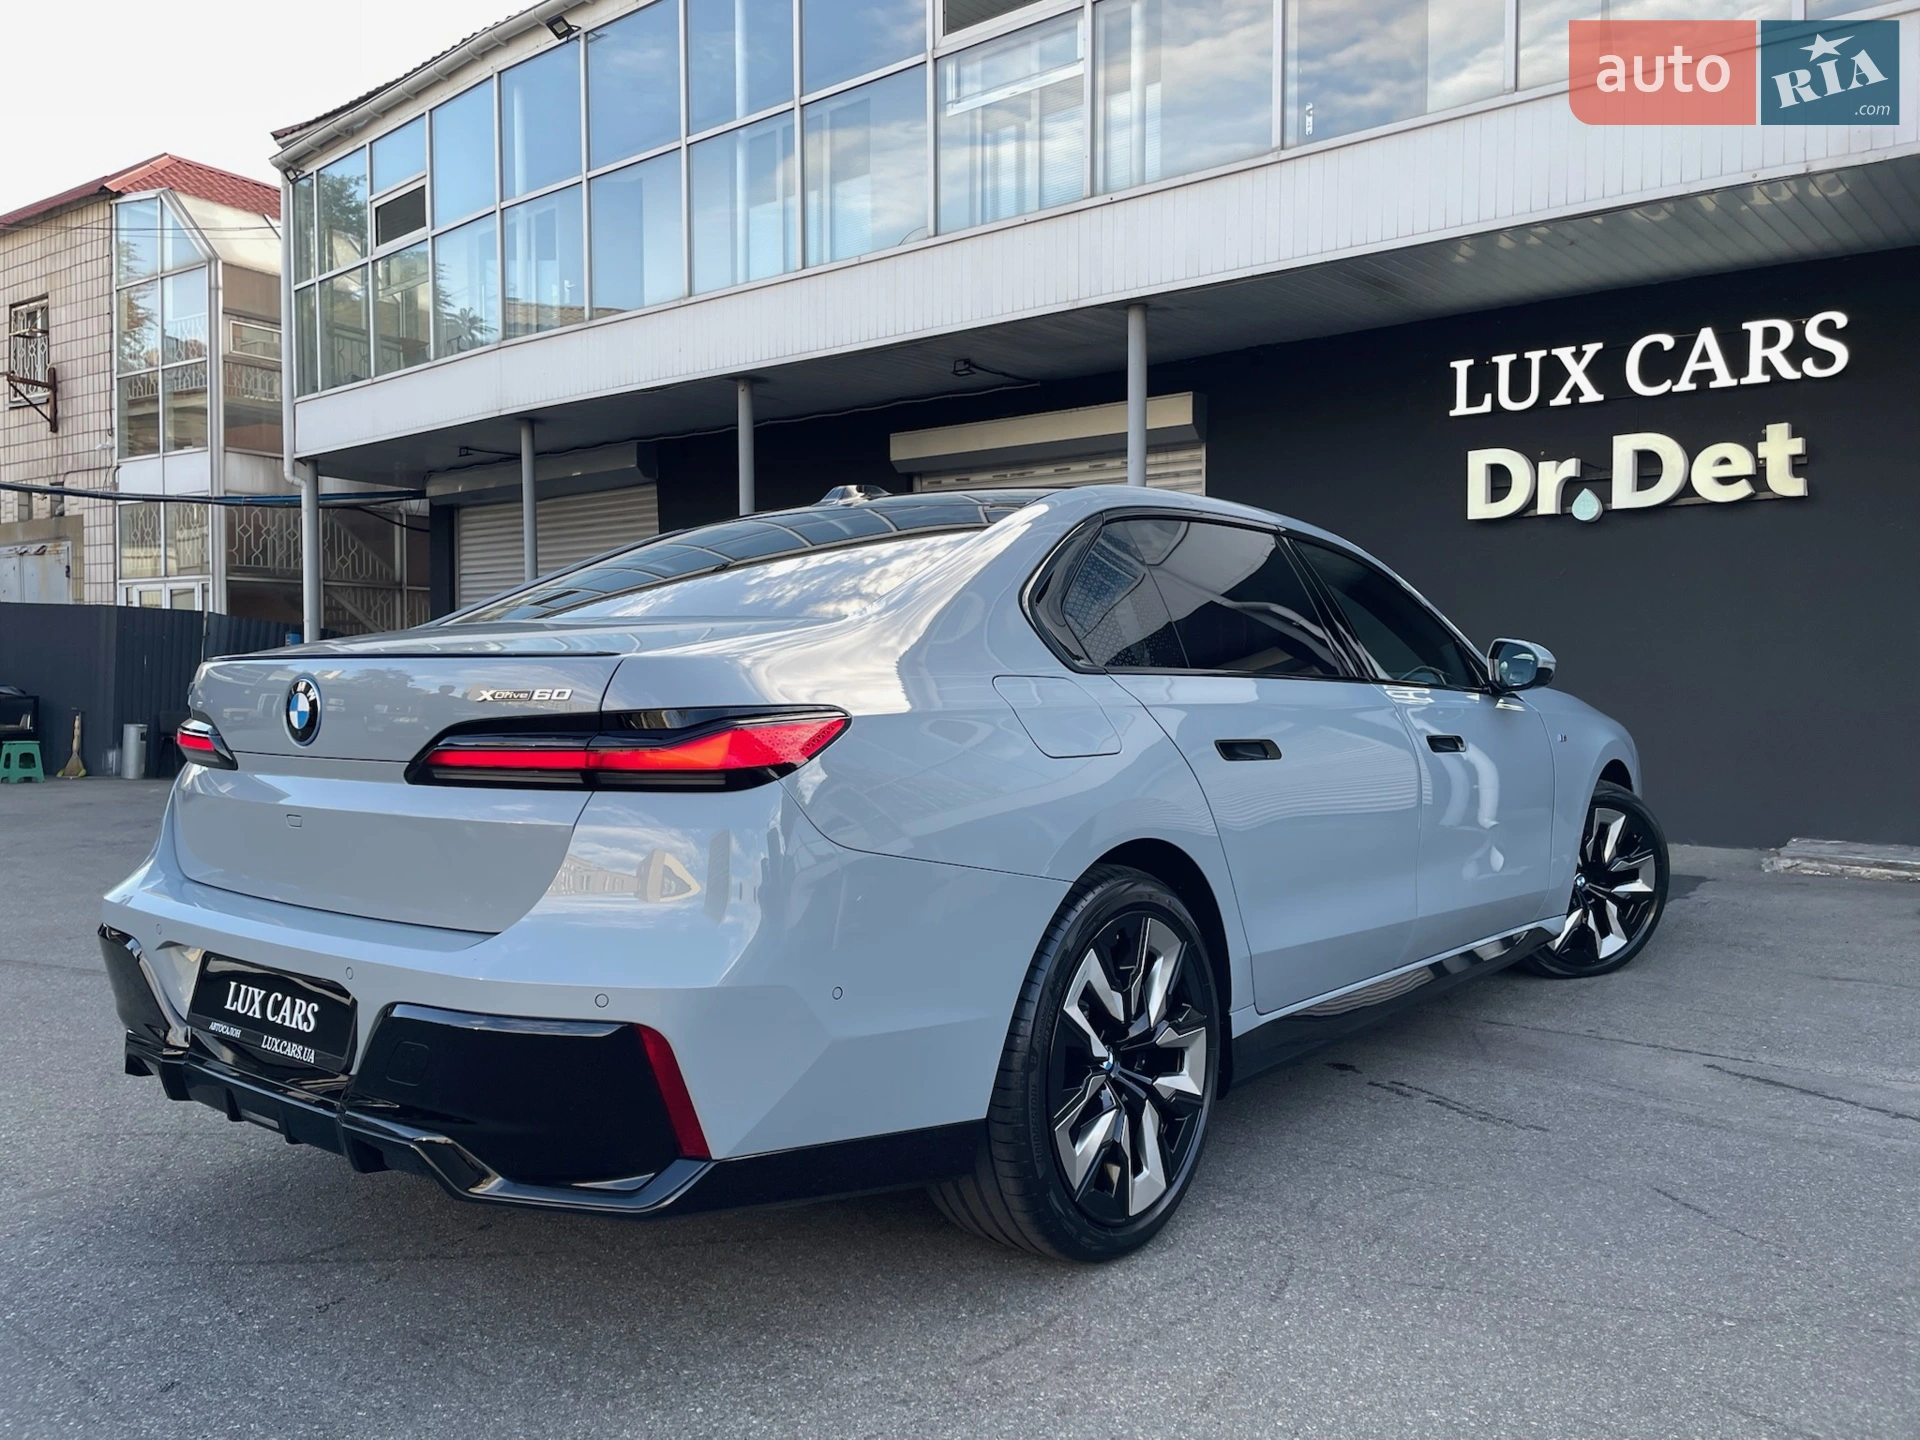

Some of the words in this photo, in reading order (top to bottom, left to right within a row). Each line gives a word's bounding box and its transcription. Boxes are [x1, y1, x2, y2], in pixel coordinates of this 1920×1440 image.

[1449, 342, 1605, 417] LUX
[1625, 311, 1849, 397] CARS
[224, 981, 267, 1019] LUX
[267, 992, 319, 1033] CARS
